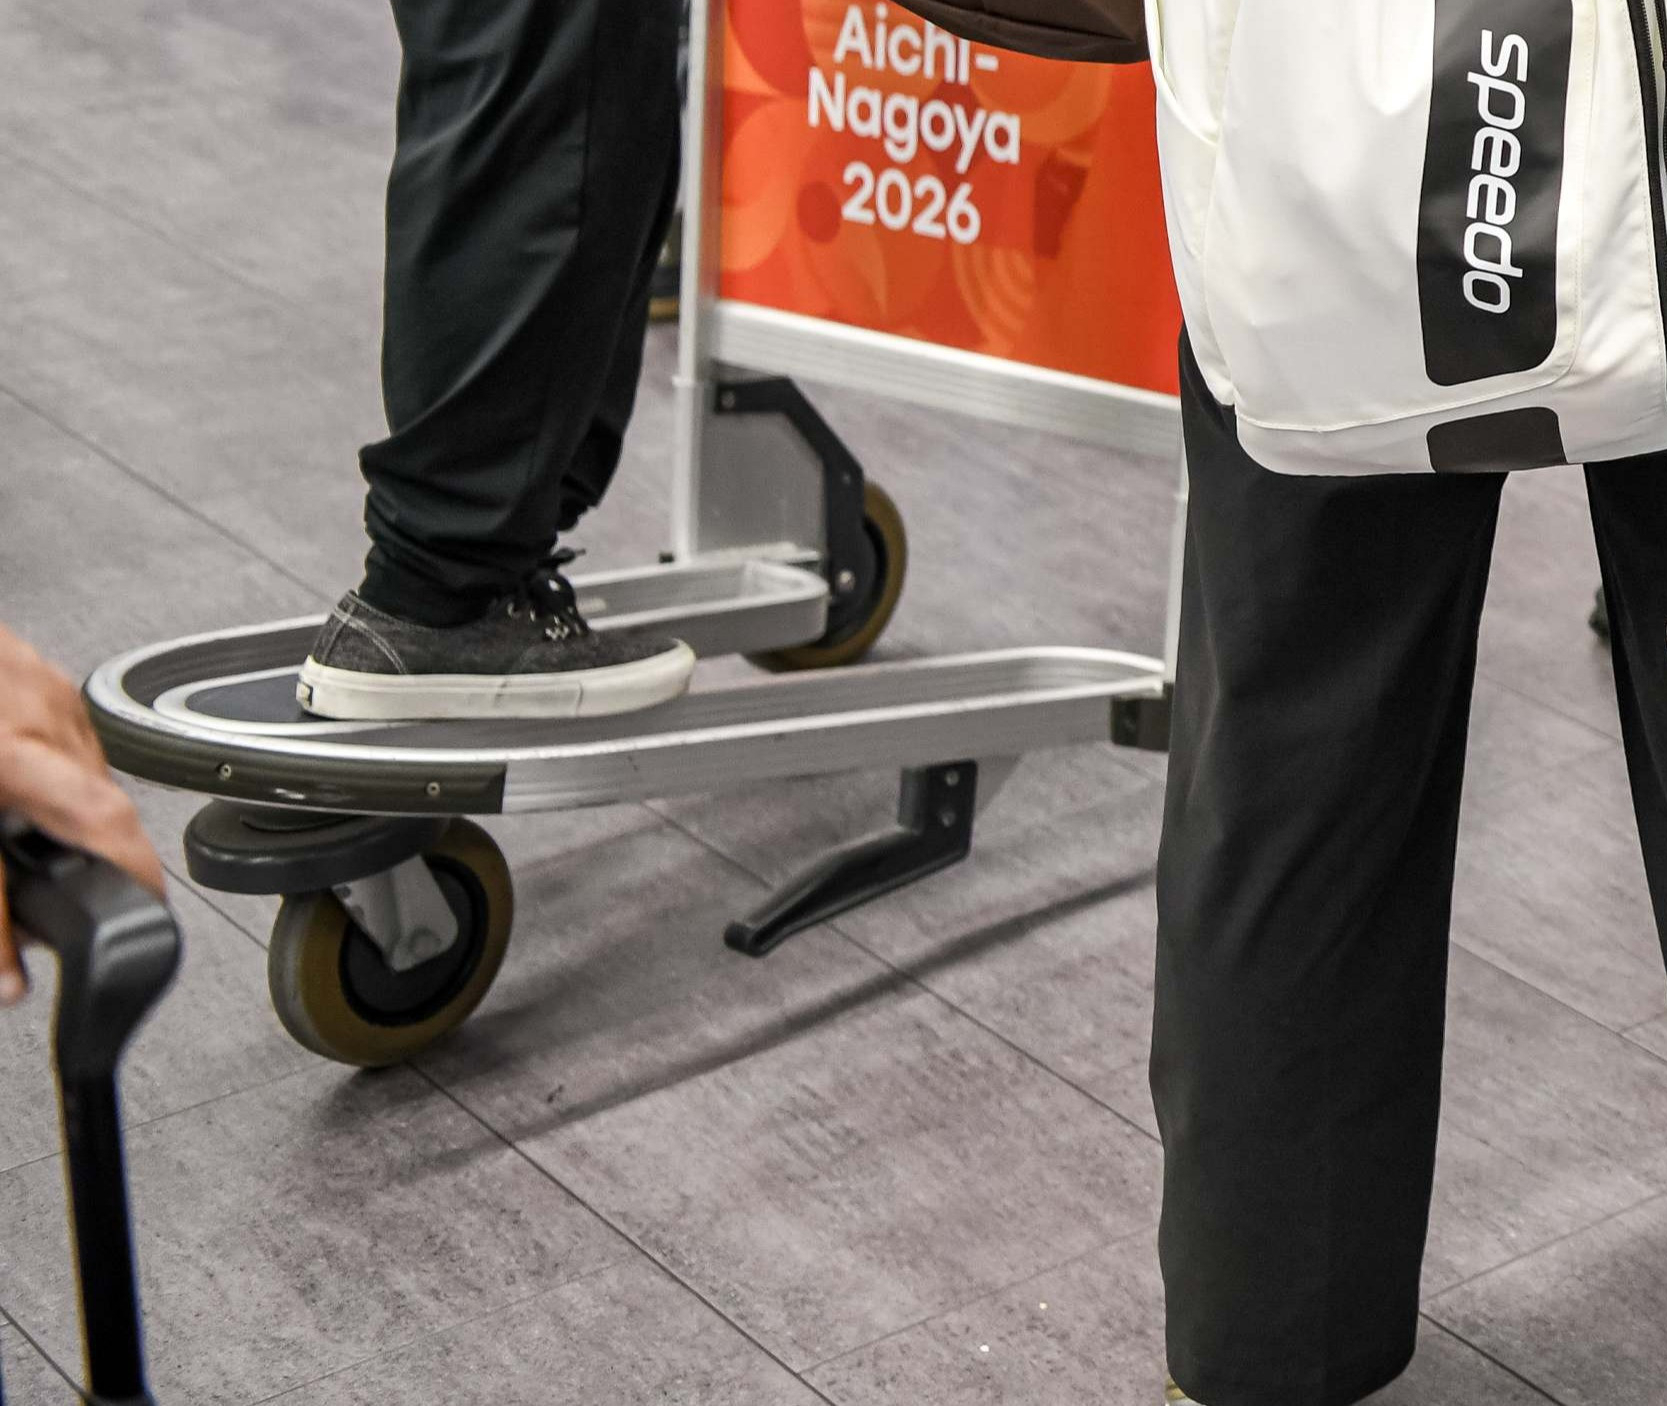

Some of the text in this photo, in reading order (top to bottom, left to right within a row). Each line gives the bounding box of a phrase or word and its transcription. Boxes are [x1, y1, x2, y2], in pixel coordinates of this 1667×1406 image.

[833, 2, 999, 86] Aichi-
[807, 66, 1021, 175] Nagoya
[841, 161, 982, 245] 2026
[1462, 28, 1530, 315] speedo
